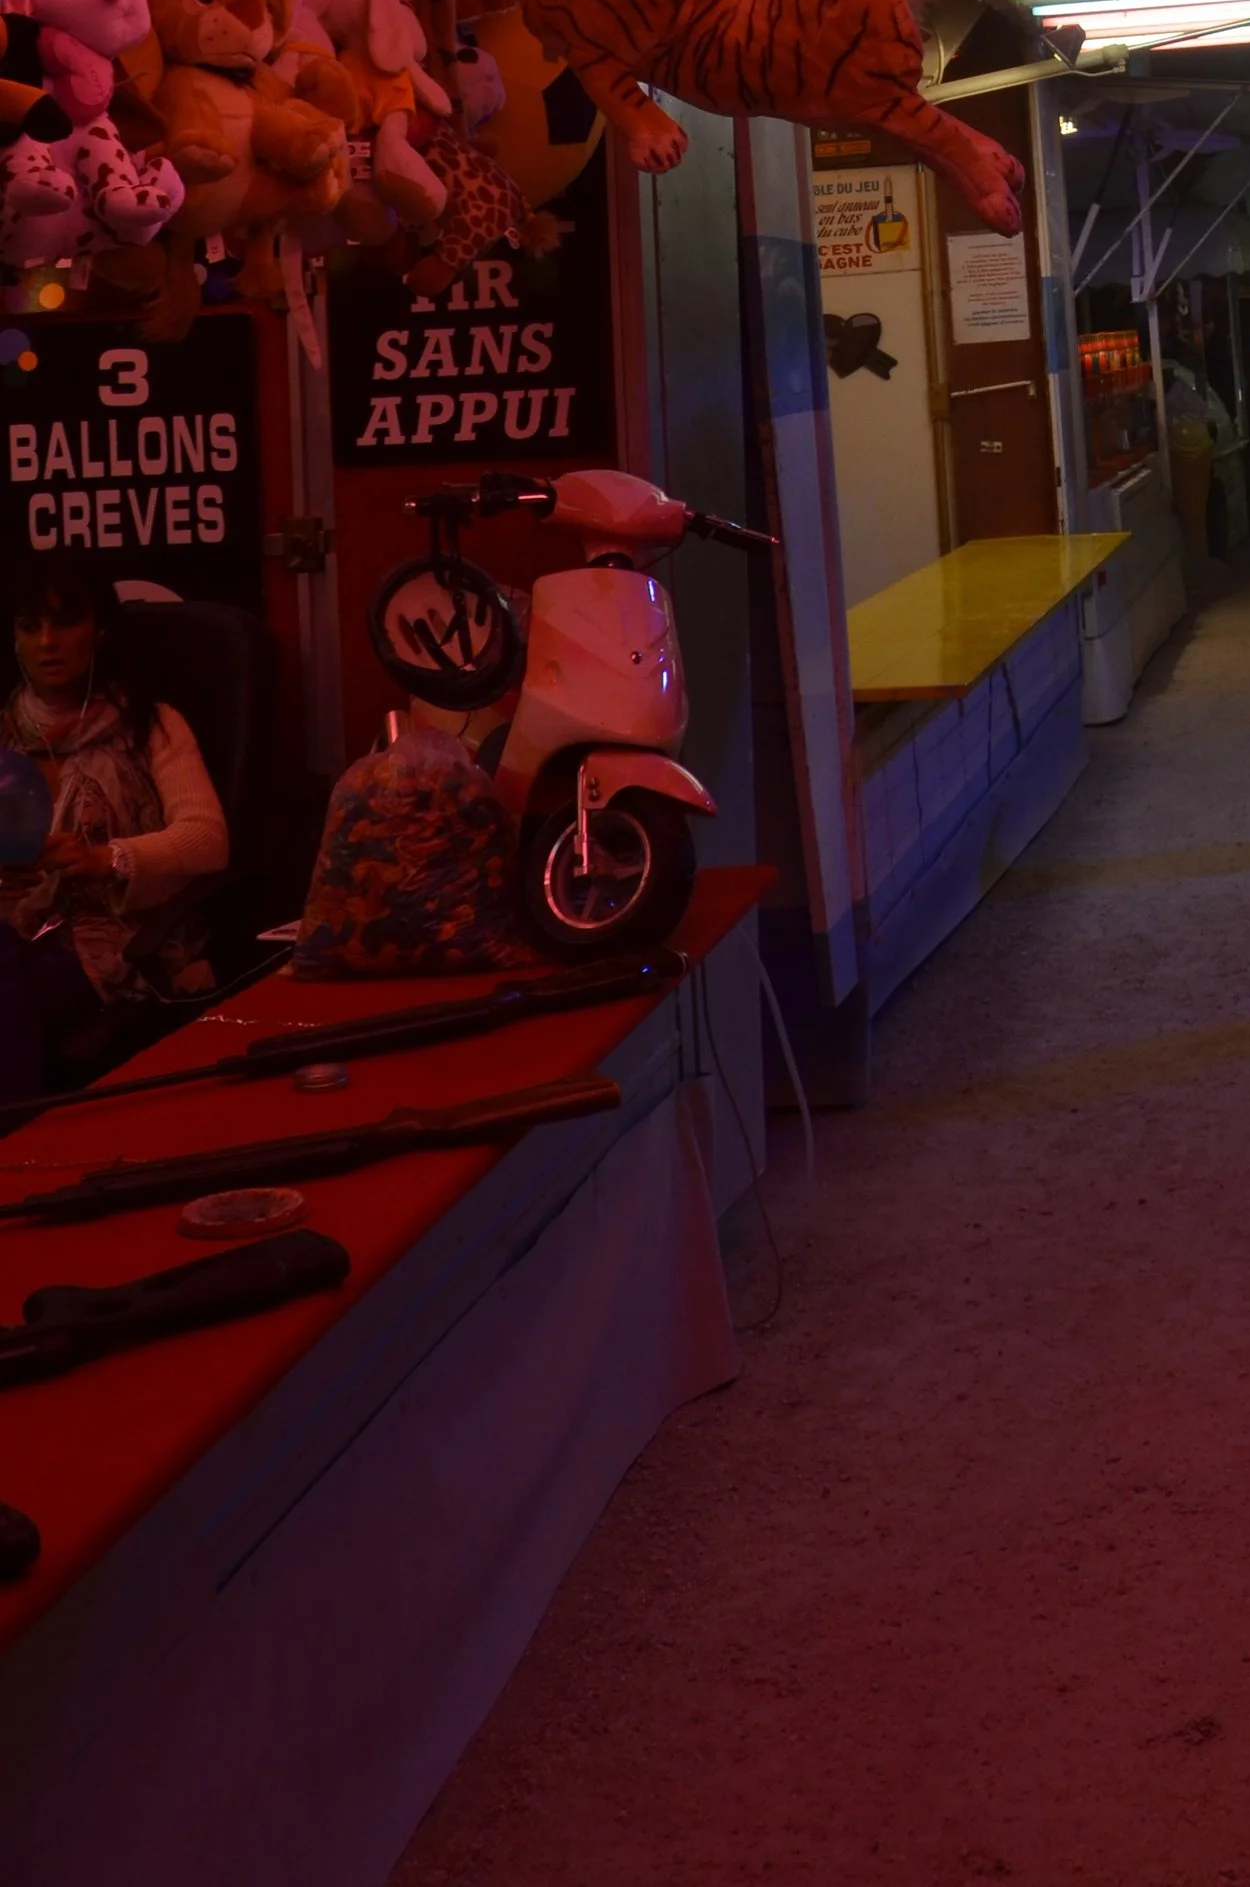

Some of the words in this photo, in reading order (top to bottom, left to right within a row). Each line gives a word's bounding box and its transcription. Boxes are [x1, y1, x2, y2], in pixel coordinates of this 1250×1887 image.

[837, 182, 852, 194] DU
[855, 180, 879, 193] JEU
[833, 224, 863, 237] cube
[837, 213, 863, 225] bas
[98, 348, 150, 407] 3
[372, 322, 555, 381] SANS
[356, 387, 577, 447] APPUI
[8, 412, 238, 482] BALLONS
[28, 484, 226, 551] CREVES
